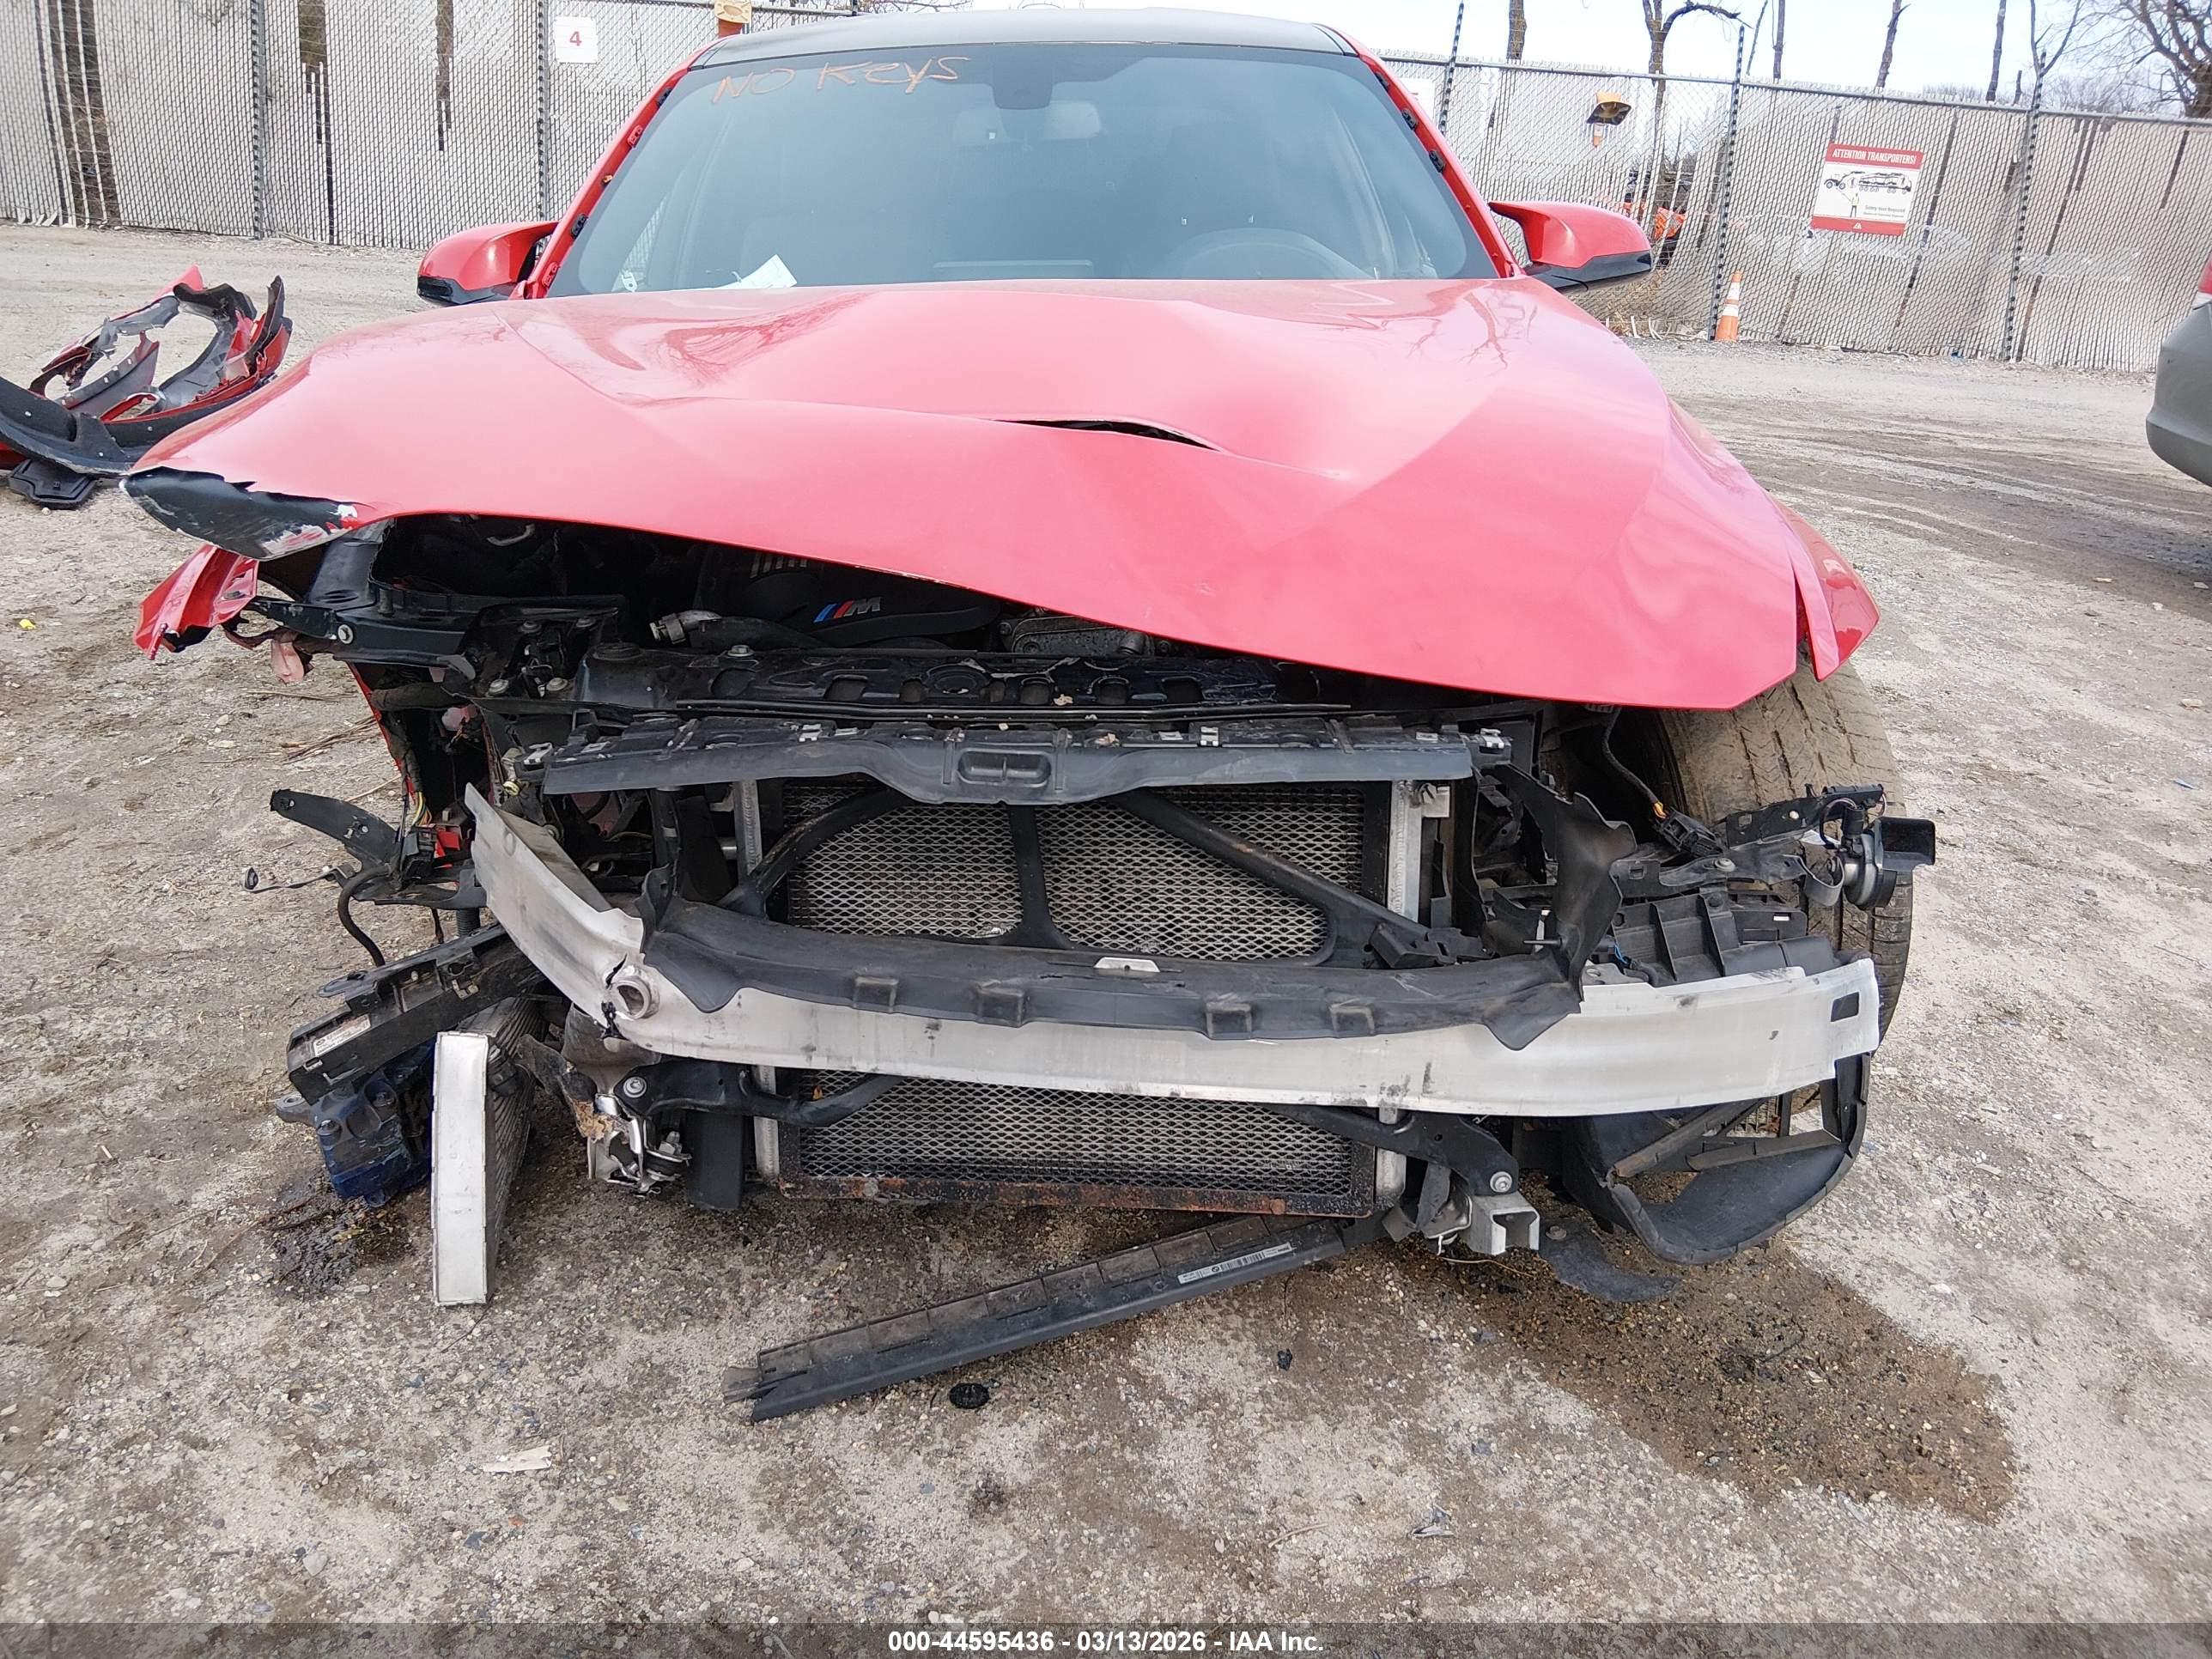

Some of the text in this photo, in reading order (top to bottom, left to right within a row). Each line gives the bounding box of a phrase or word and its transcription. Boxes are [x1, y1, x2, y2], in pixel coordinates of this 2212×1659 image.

[569, 31, 582, 46] 4
[1832, 149, 1917, 164] ATTENTION TRANSPORTERS!
